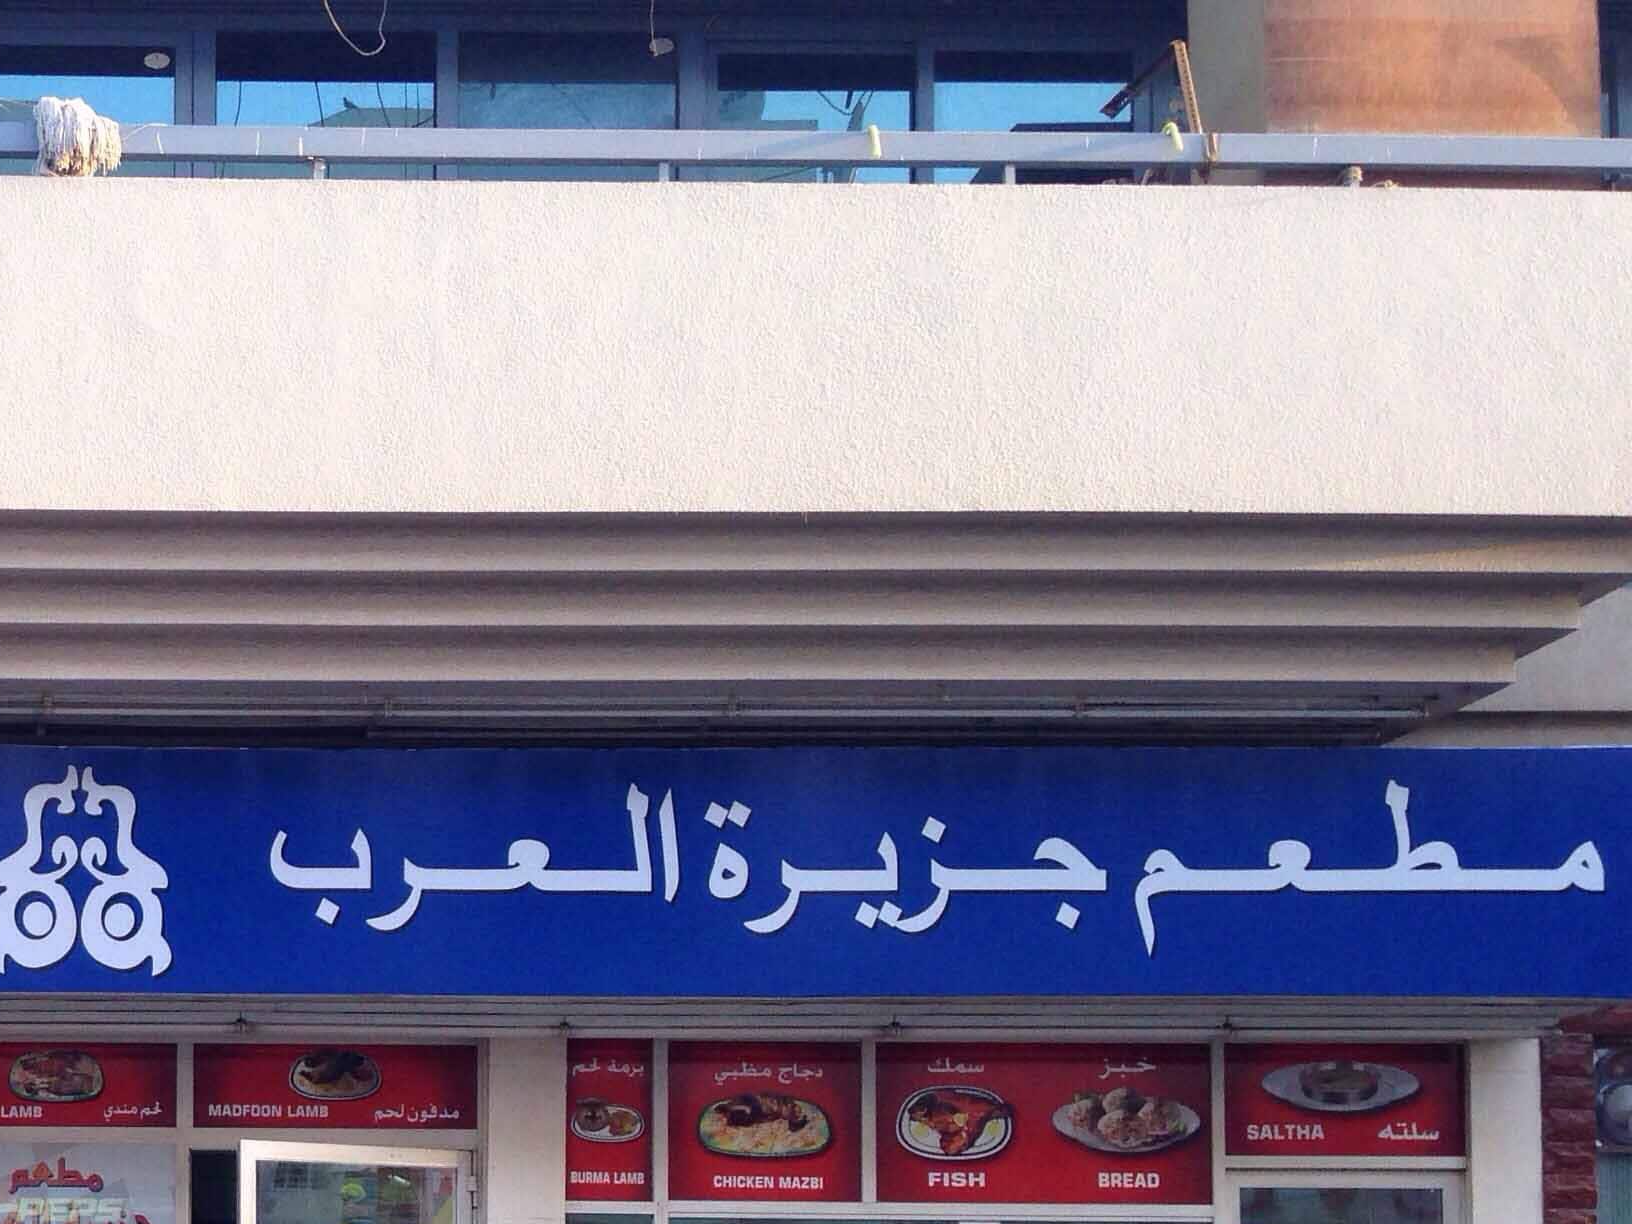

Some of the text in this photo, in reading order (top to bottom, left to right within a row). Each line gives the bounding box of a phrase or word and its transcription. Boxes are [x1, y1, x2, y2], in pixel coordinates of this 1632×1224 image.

[269, 779, 1606, 958] مطعم جزيرة العرب
[0, 1105, 43, 1119] LAMB
[208, 1104, 329, 1118] MADFOON LAMB
[1246, 1124, 1325, 1141] SALTHA
[8, 1156, 104, 1195] مطعم
[569, 1171, 646, 1185] BURMA LAMB
[713, 1175, 825, 1190] CHICKEN MAZBI
[927, 1172, 986, 1188] FISH
[1097, 1172, 1160, 1188] BREAD
